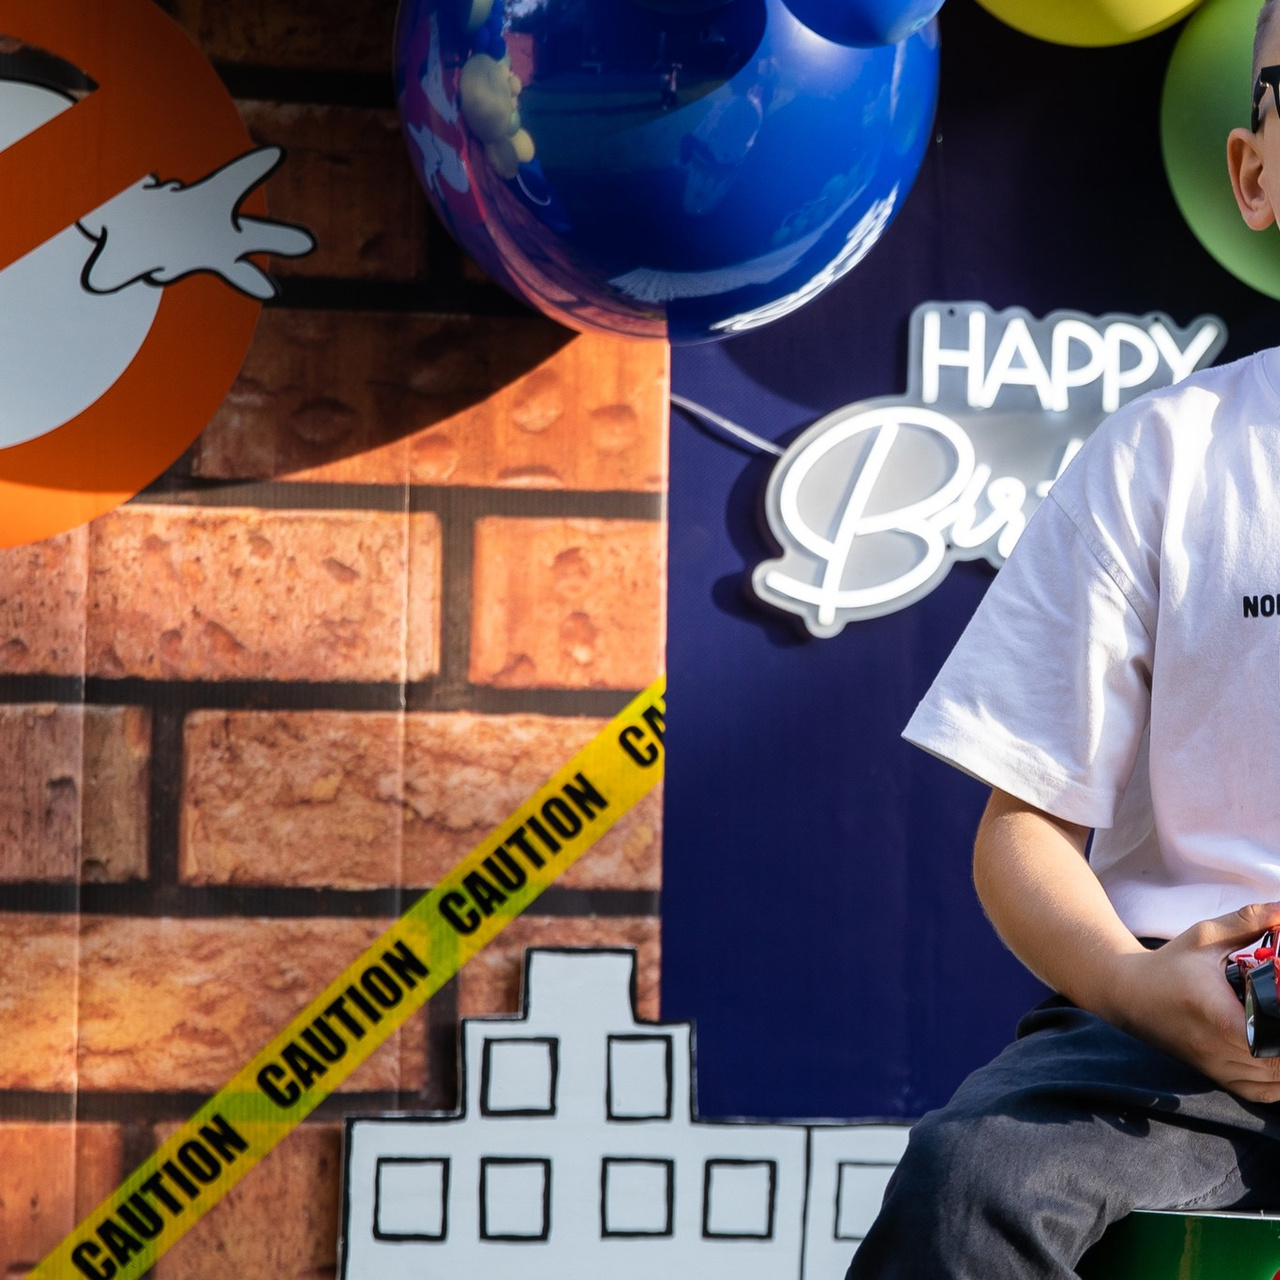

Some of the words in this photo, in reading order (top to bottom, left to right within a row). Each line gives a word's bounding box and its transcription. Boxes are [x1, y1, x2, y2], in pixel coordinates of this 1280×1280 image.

[921, 310, 1219, 413] HAPPY
[256, 939, 430, 1109] CAUTION
[437, 772, 609, 936] CAUTION
